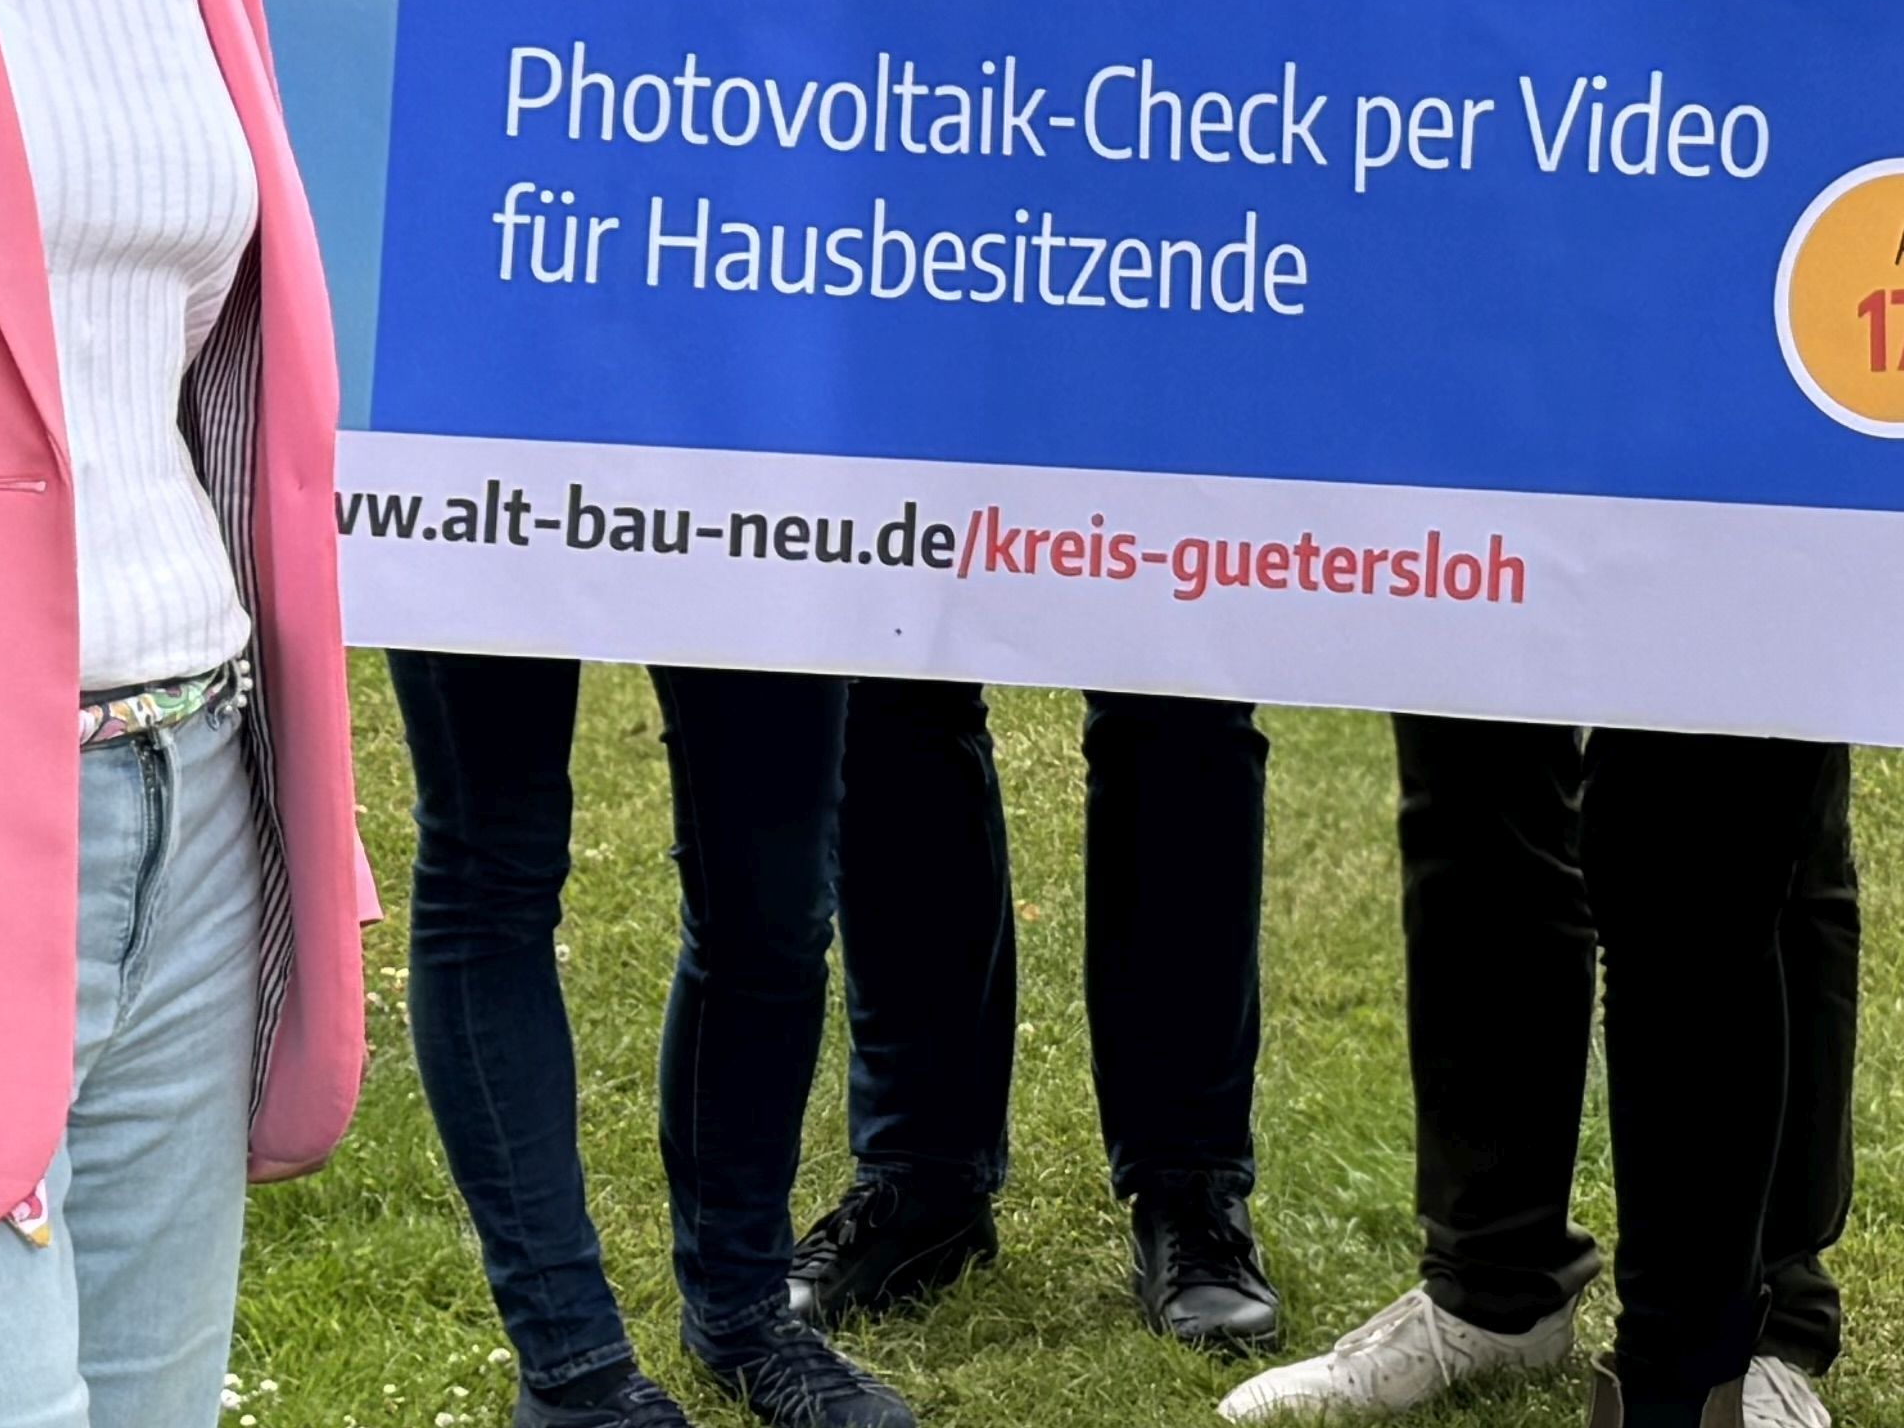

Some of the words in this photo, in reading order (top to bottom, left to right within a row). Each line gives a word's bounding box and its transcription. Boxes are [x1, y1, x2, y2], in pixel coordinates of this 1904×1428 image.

[507, 42, 1327, 164] Photovoltaik-Check
[1356, 97, 1494, 192] per
[1520, 71, 1768, 177] Video
[493, 183, 619, 283] für
[647, 197, 1306, 314] Hausbesitzende
